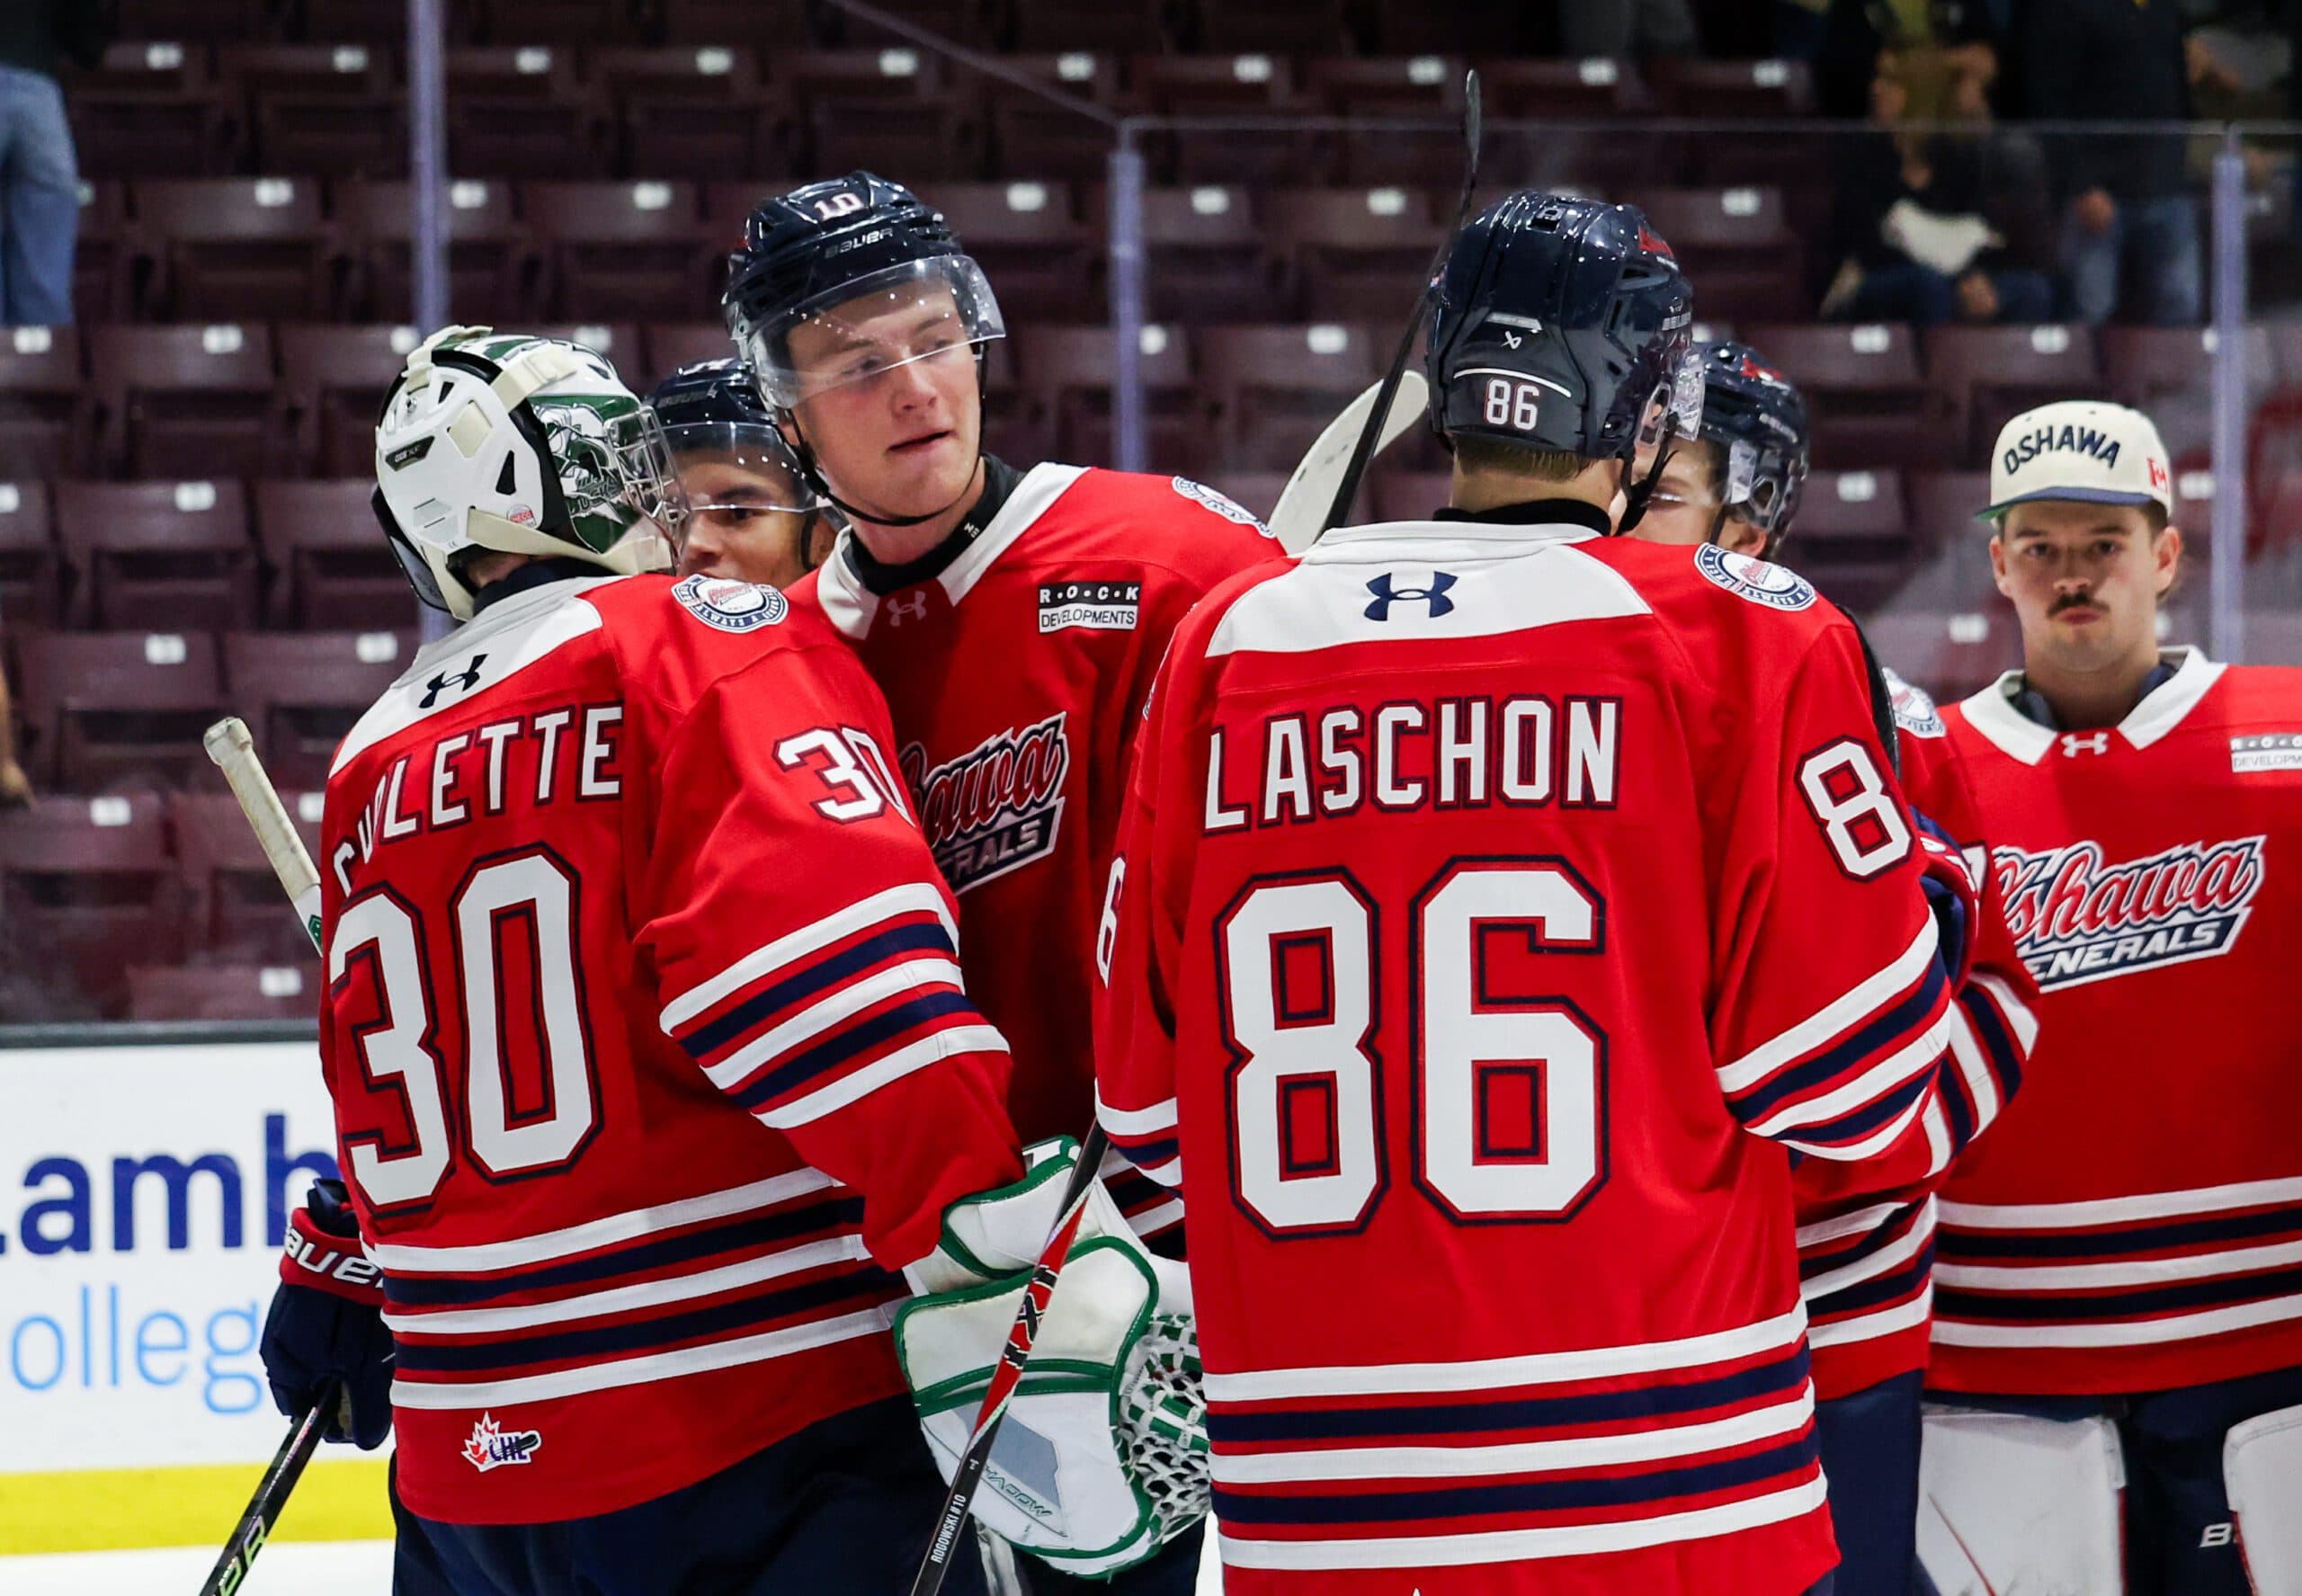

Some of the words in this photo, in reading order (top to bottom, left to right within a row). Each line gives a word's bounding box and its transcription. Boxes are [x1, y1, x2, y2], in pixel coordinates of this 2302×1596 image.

[814, 192, 864, 221] 10
[1486, 377, 1540, 432] 86
[2003, 424, 2121, 476] OSHAWA
[1041, 609, 1135, 628] DEVELOPMENTS
[772, 725, 916, 824] 30
[1203, 696, 1621, 835] LASCHON
[1800, 736, 1916, 881] 8
[2023, 920, 2219, 982] ENERALS
[329, 842, 604, 1218] 30
[1214, 855, 1608, 1240] 86
[11, 1284, 263, 1415] olleg
[487, 1434, 529, 1462] CHL
